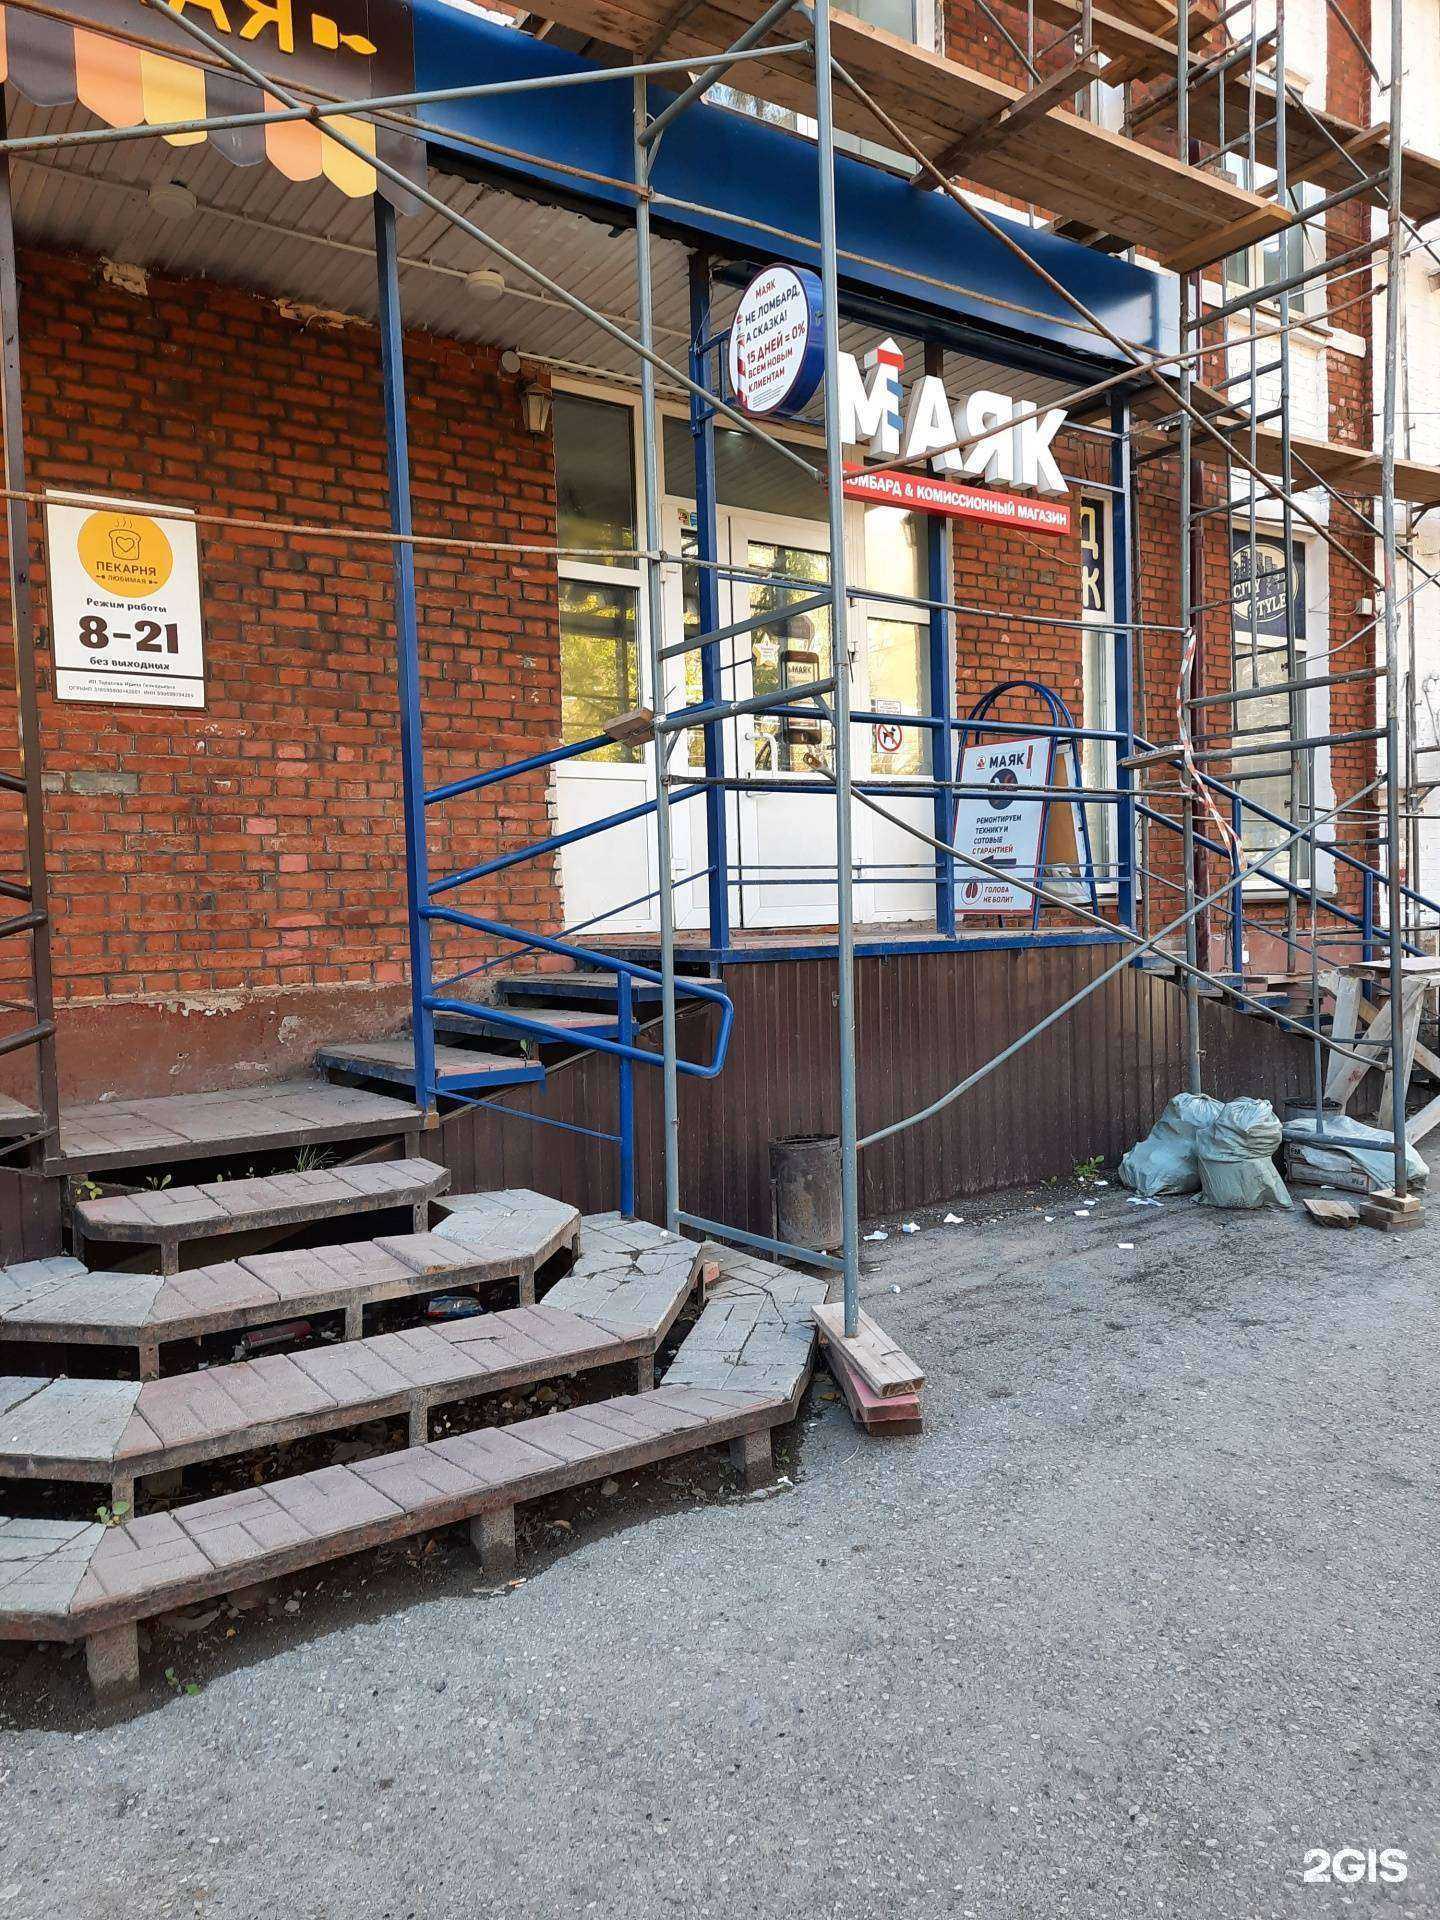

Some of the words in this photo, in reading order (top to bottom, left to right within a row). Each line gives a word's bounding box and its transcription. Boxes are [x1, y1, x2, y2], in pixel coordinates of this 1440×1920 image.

[756, 278, 776, 299] МАЯК
[745, 311, 756, 326] НЕ
[746, 332, 752, 344] А
[753, 309, 788, 339] СКАЗКА!
[747, 350, 756, 365] 15
[758, 330, 783, 362] ДНЕЙ
[792, 320, 806, 340] 0%
[748, 362, 766, 379] ВСЕМ
[767, 346, 793, 368] НОВЫМ
[749, 366, 785, 393] КЛИЕНТАМ
[830, 337, 1069, 496] МАЯК
[904, 482, 915, 498] &
[916, 484, 1016, 516] КОМИССИОННЫЙ
[1017, 505, 1068, 526] МАГАЗИН
[96, 561, 157, 577] ПЕКАРНЯ
[108, 574, 147, 585] ЛЮБИМАЯ
[86, 598, 125, 609] Режим
[127, 602, 168, 613] работы
[1249, 592, 1287, 618] TYLE
[89, 656, 109, 667] без
[111, 659, 171, 671] выходных
[989, 752, 1025, 769] МАЯК
[976, 814, 1022, 824] РЕМОНТИРУЕМ
[975, 826, 1003, 834] ТЕХНИКУ
[1003, 825, 1009, 833] И
[973, 836, 1003, 845] СОТОВЫЕ
[972, 847, 977, 855] С
[976, 844, 1014, 855] ГАРАНТИЕЙ
[984, 886, 1010, 894] ГОЛОВА
